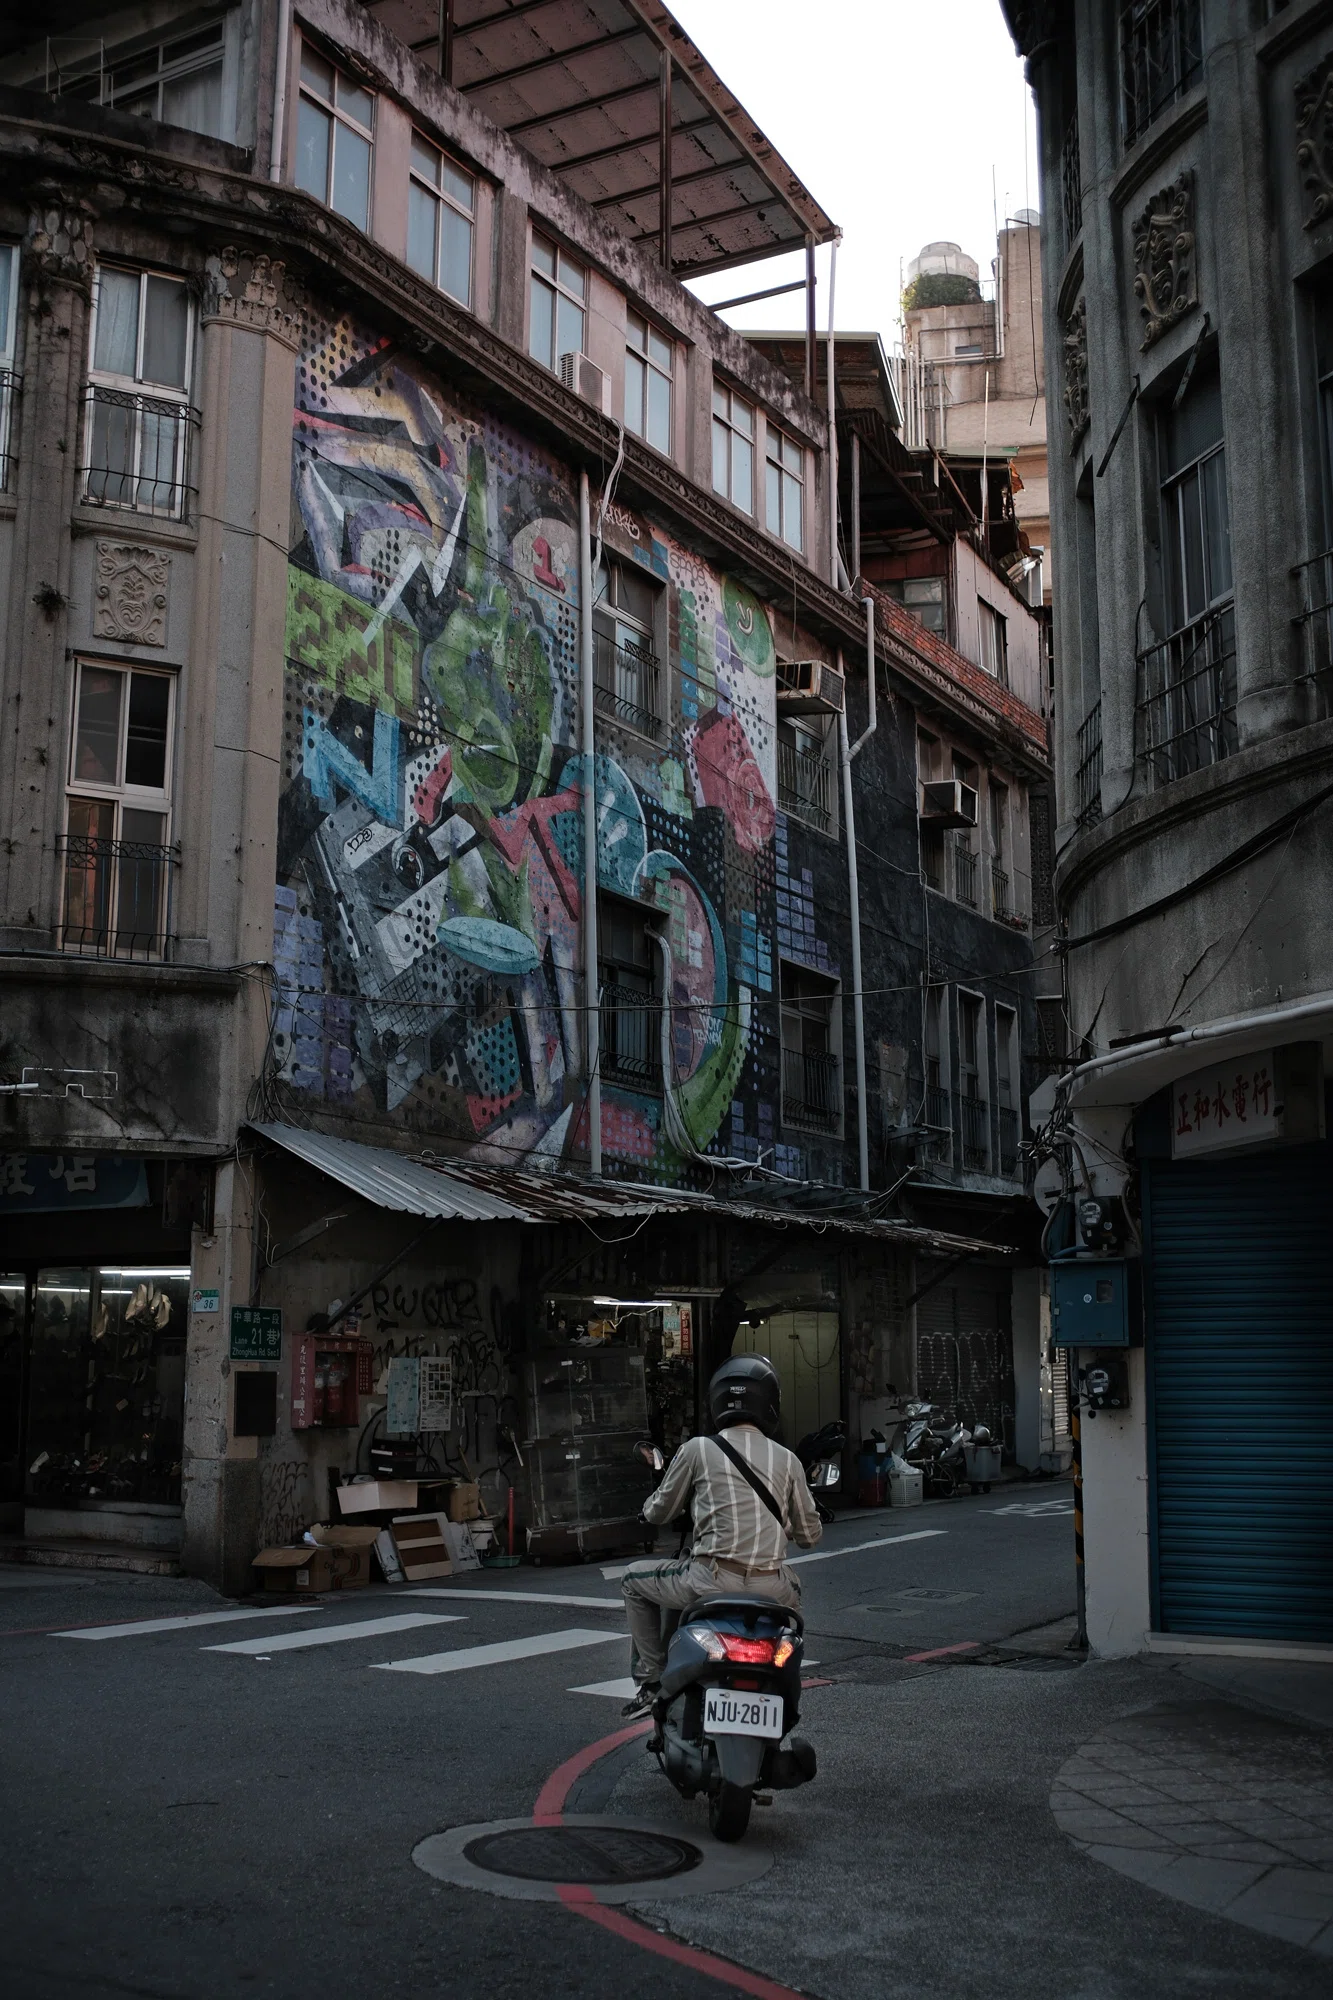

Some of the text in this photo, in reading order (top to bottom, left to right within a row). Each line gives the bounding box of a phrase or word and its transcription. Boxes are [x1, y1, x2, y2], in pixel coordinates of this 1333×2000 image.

[1176, 1067, 1272, 1136] 正和水電行
[203, 1299, 214, 1309] 36
[234, 1310, 280, 1324] 中華路一段
[234, 1327, 277, 1345] Lane 21 巷
[232, 1347, 257, 1357] ZhongHua
